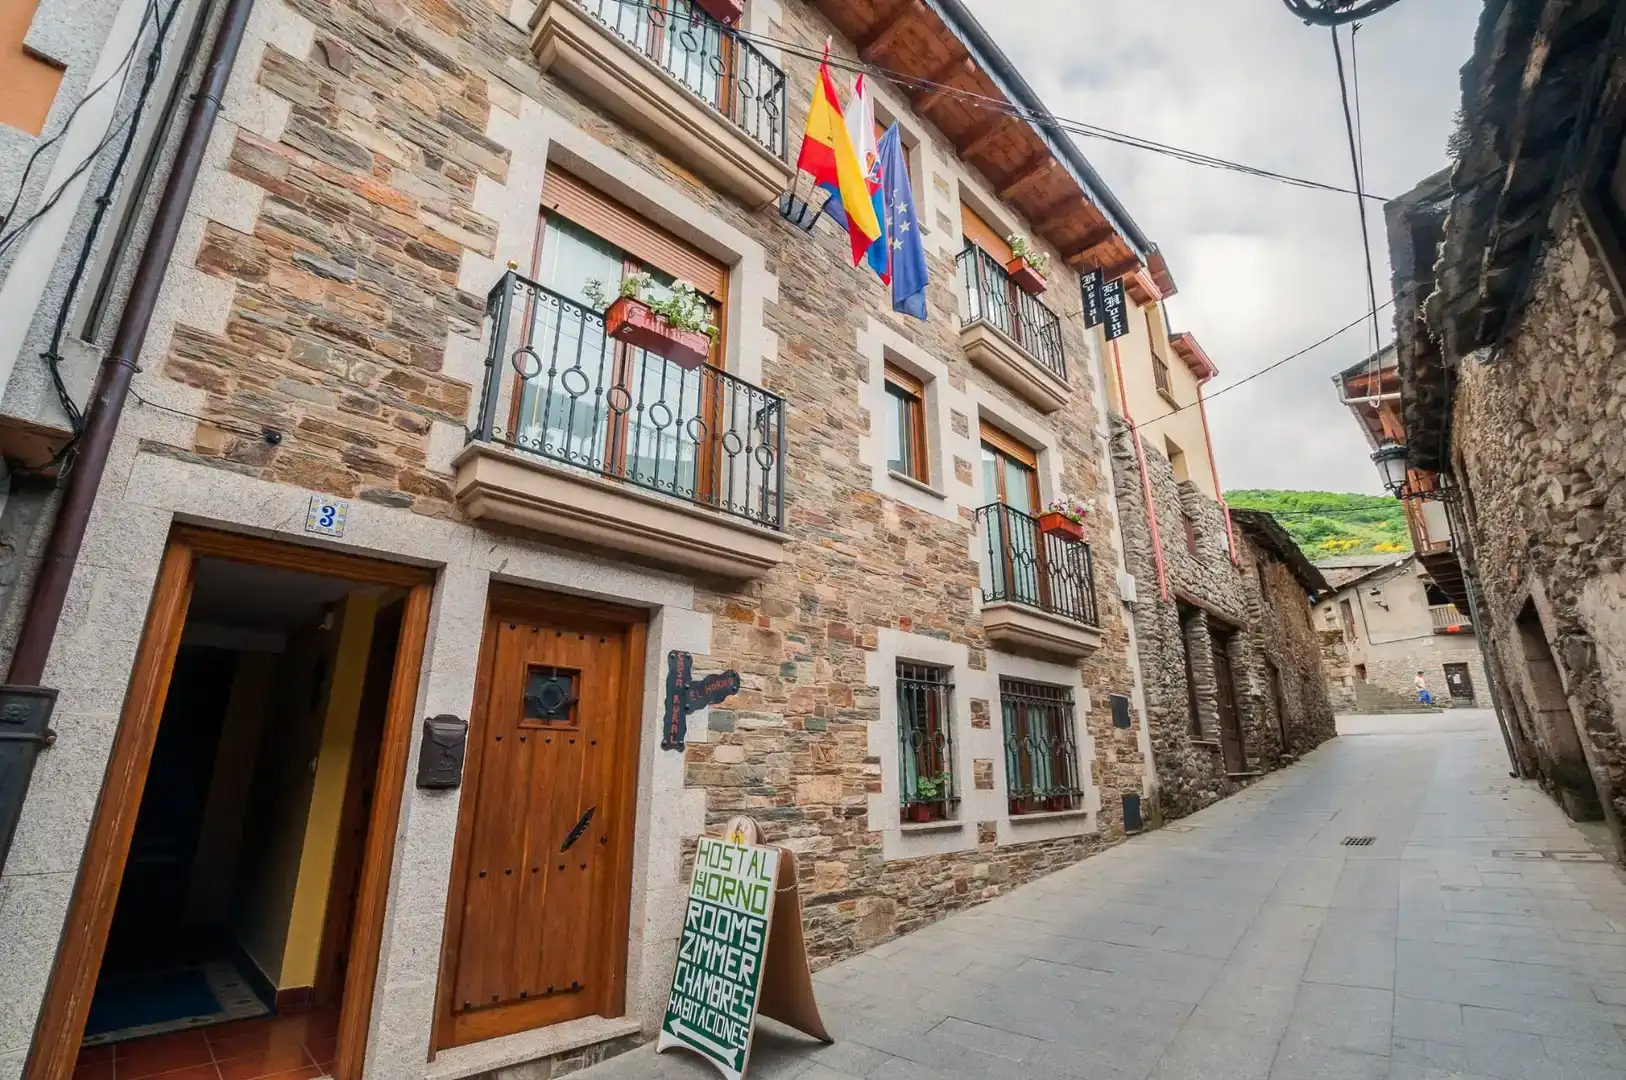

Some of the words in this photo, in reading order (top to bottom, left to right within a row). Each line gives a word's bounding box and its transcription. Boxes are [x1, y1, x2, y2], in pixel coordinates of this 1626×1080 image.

[1082, 272, 1097, 325] Hostal
[1102, 281, 1119, 296] El
[1104, 294, 1122, 337] Horno
[320, 506, 336, 527] 3
[676, 652, 684, 687] CASA
[670, 695, 679, 744] RURAL
[698, 839, 771, 882] HOSTAL
[692, 869, 768, 915] HORNO
[686, 903, 763, 953] ROOMS
[680, 930, 756, 986] ZIMMER
[674, 961, 754, 1022] CHAMBRES
[668, 993, 749, 1050] HABITACIONES
